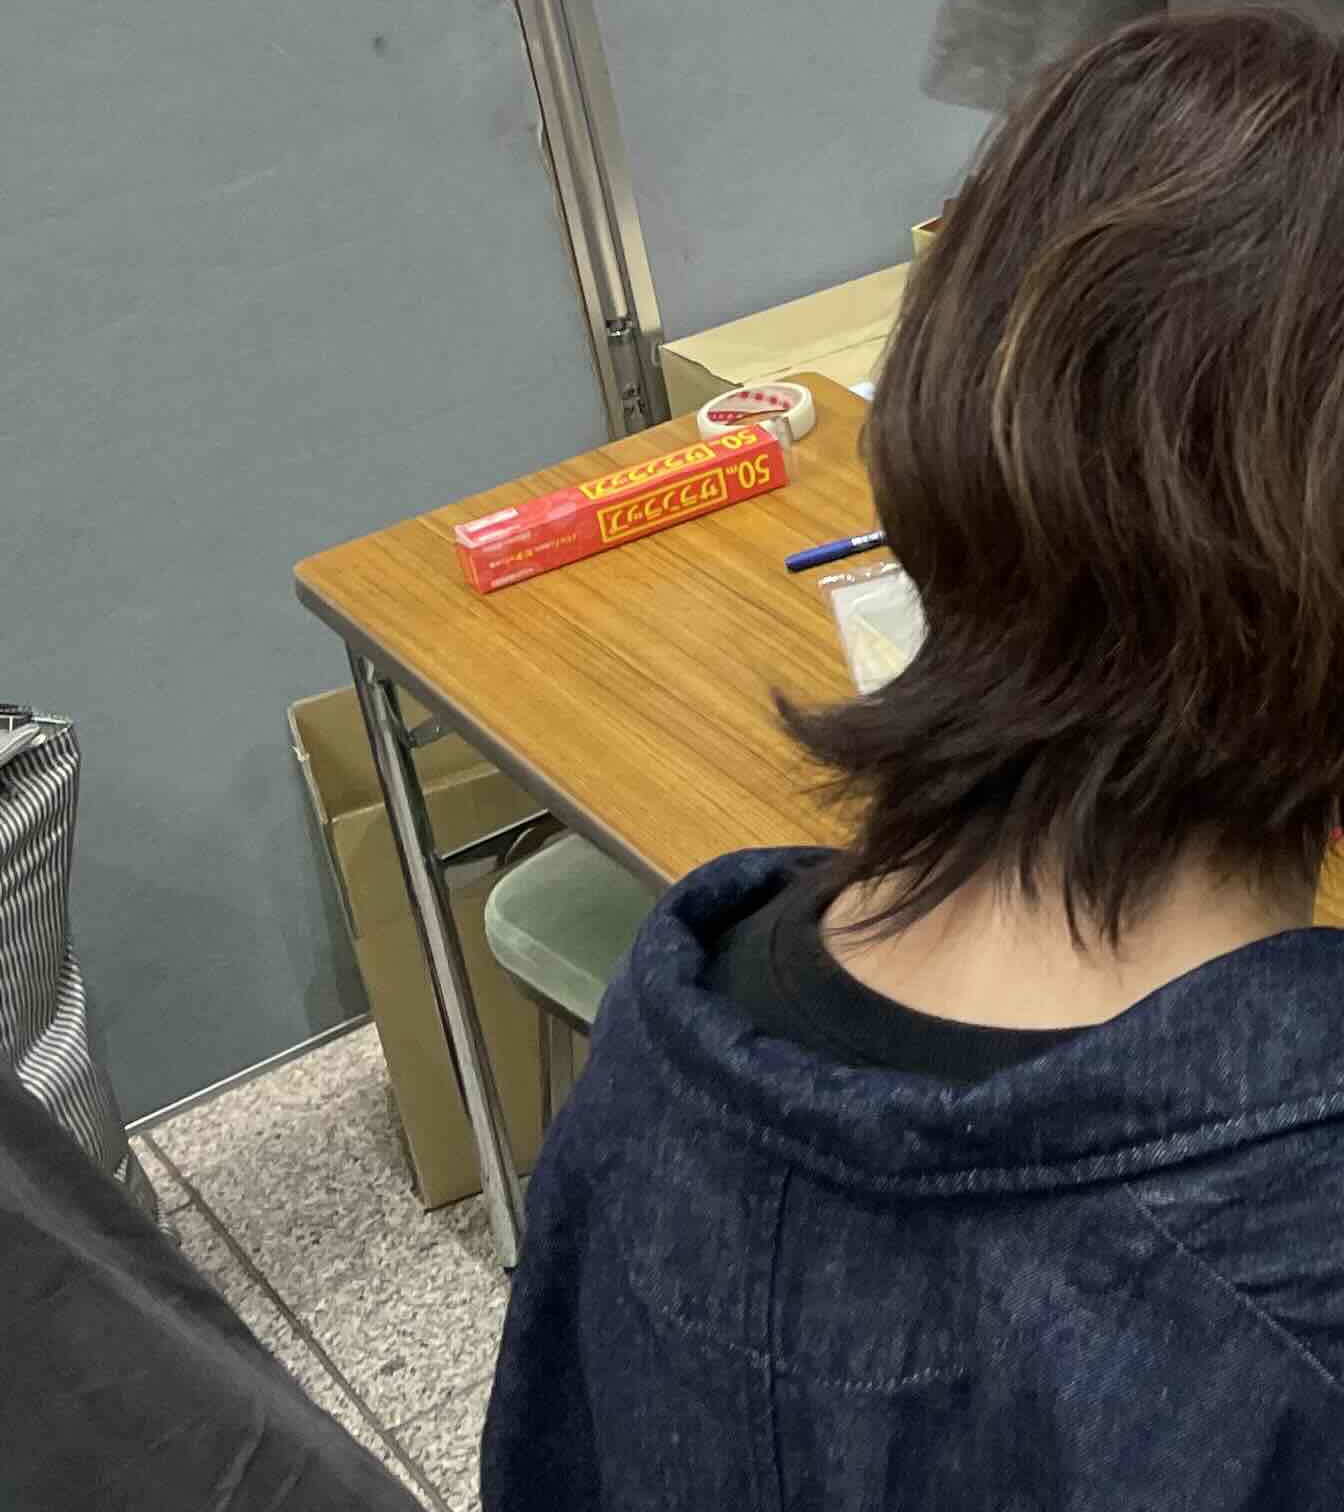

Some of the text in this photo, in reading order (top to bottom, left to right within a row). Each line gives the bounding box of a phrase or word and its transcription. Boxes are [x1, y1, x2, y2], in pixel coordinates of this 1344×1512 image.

[608, 477, 720, 535] サランラップ
